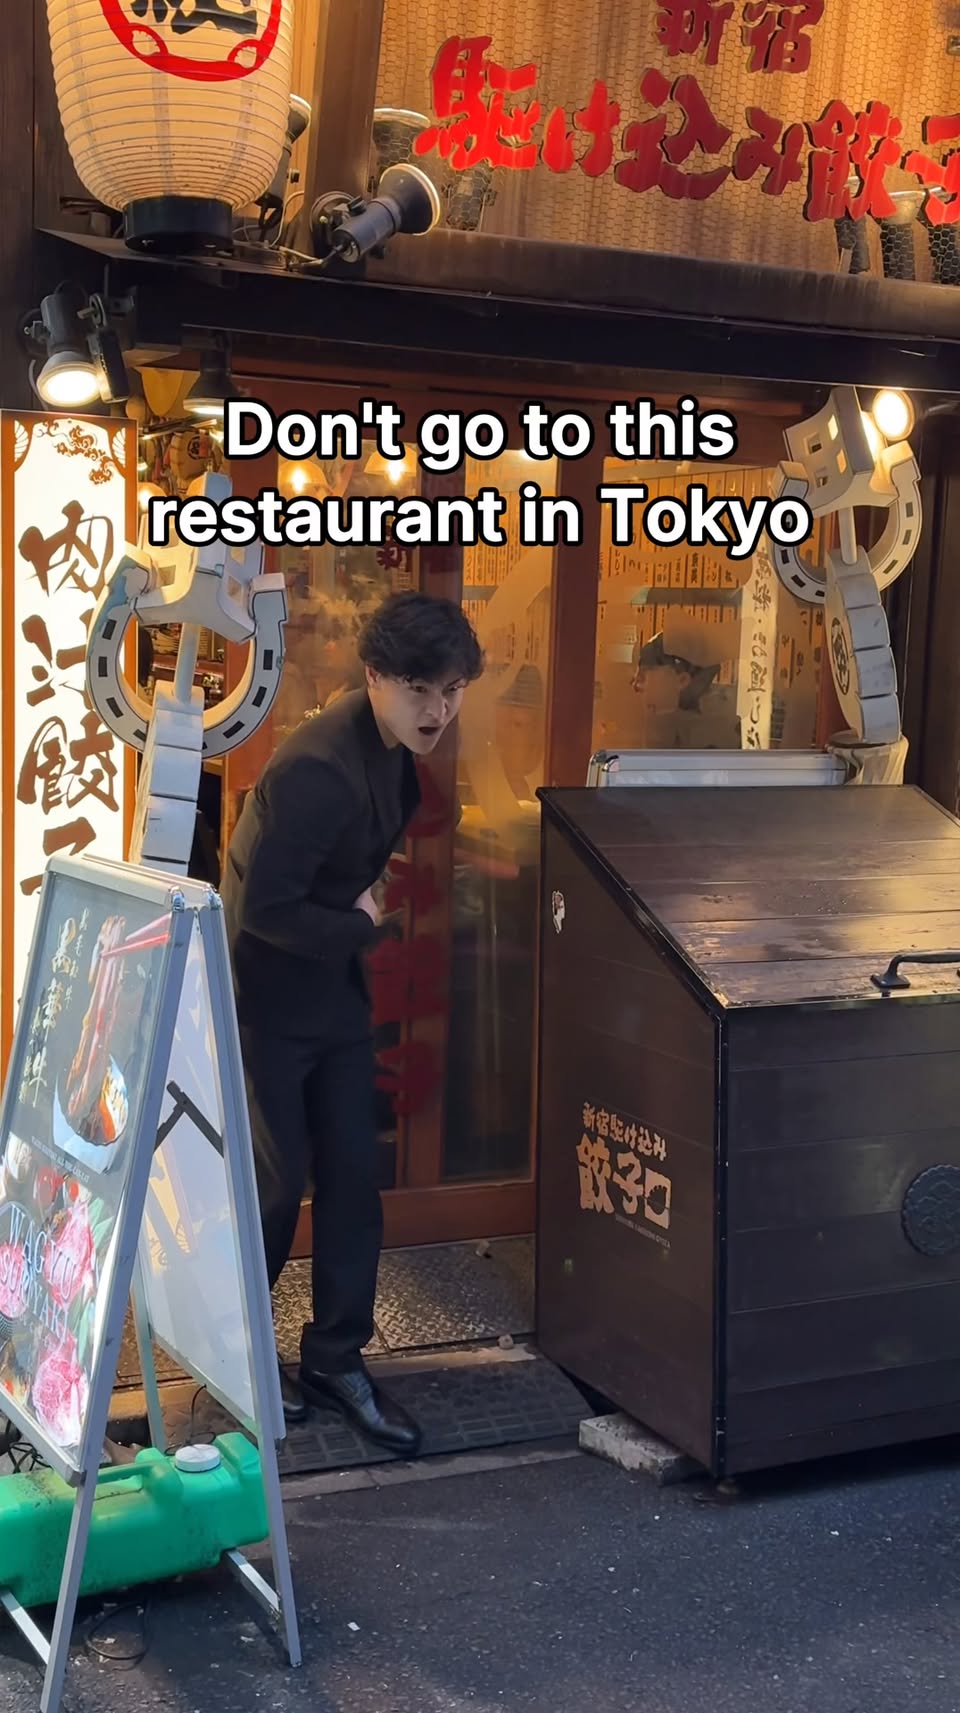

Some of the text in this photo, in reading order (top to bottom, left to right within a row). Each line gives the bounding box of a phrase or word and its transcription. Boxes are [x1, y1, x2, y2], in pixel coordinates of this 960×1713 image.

[583, 1101, 667, 1162] 新宿駆け込み
[8, 1203, 77, 1301] WAGYU
